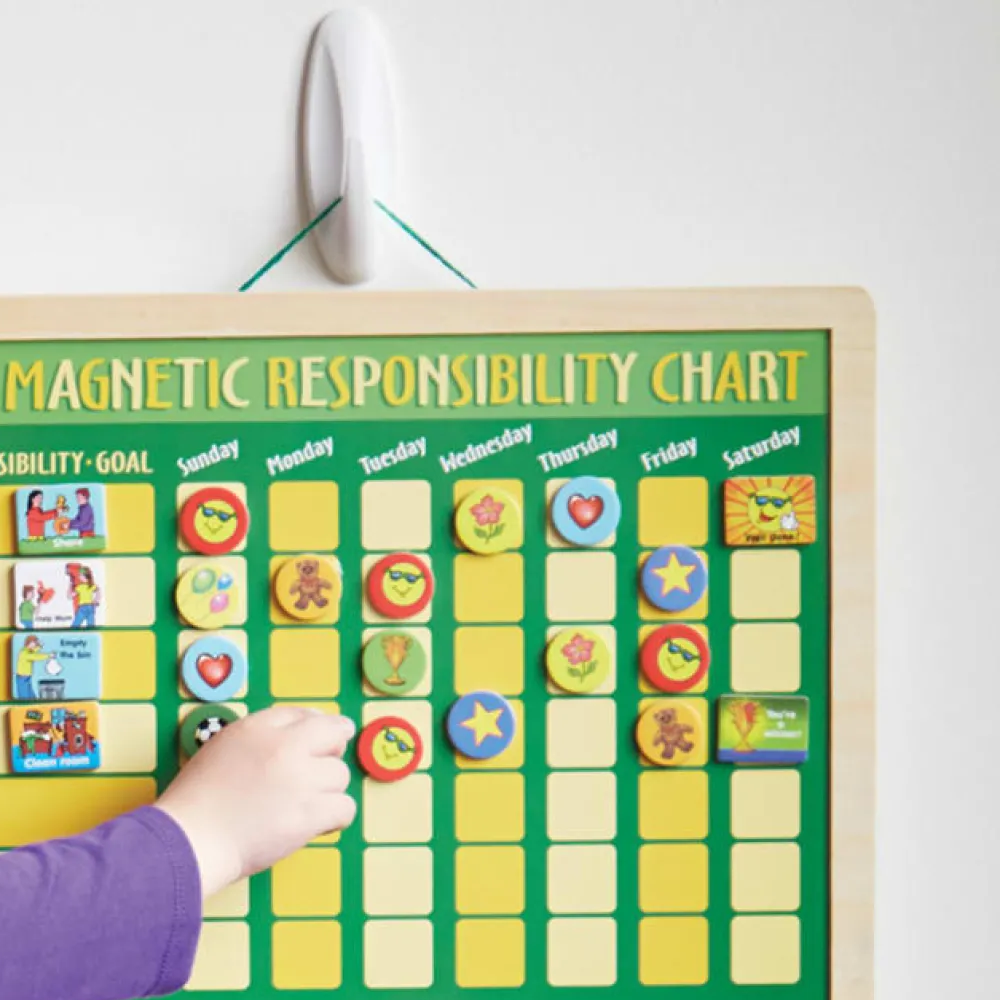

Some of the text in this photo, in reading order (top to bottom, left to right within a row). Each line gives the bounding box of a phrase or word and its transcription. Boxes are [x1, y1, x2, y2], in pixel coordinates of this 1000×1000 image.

[5, 356, 250, 411] MAGNETIC
[267, 351, 639, 409] RESPONSIBILITY
[651, 349, 808, 404] CHART
[95, 450, 154, 475] GOAL
[177, 438, 239, 478] Sunday
[265, 435, 333, 477] Monday
[357, 435, 427, 475] Tuesday
[438, 422, 532, 474] Wednesday
[536, 428, 617, 472] Thursday
[640, 436, 698, 472] Friday
[722, 425, 799, 471] Saturday
[60, 638, 88, 648] Empty
[23, 756, 91, 769] Clean room
